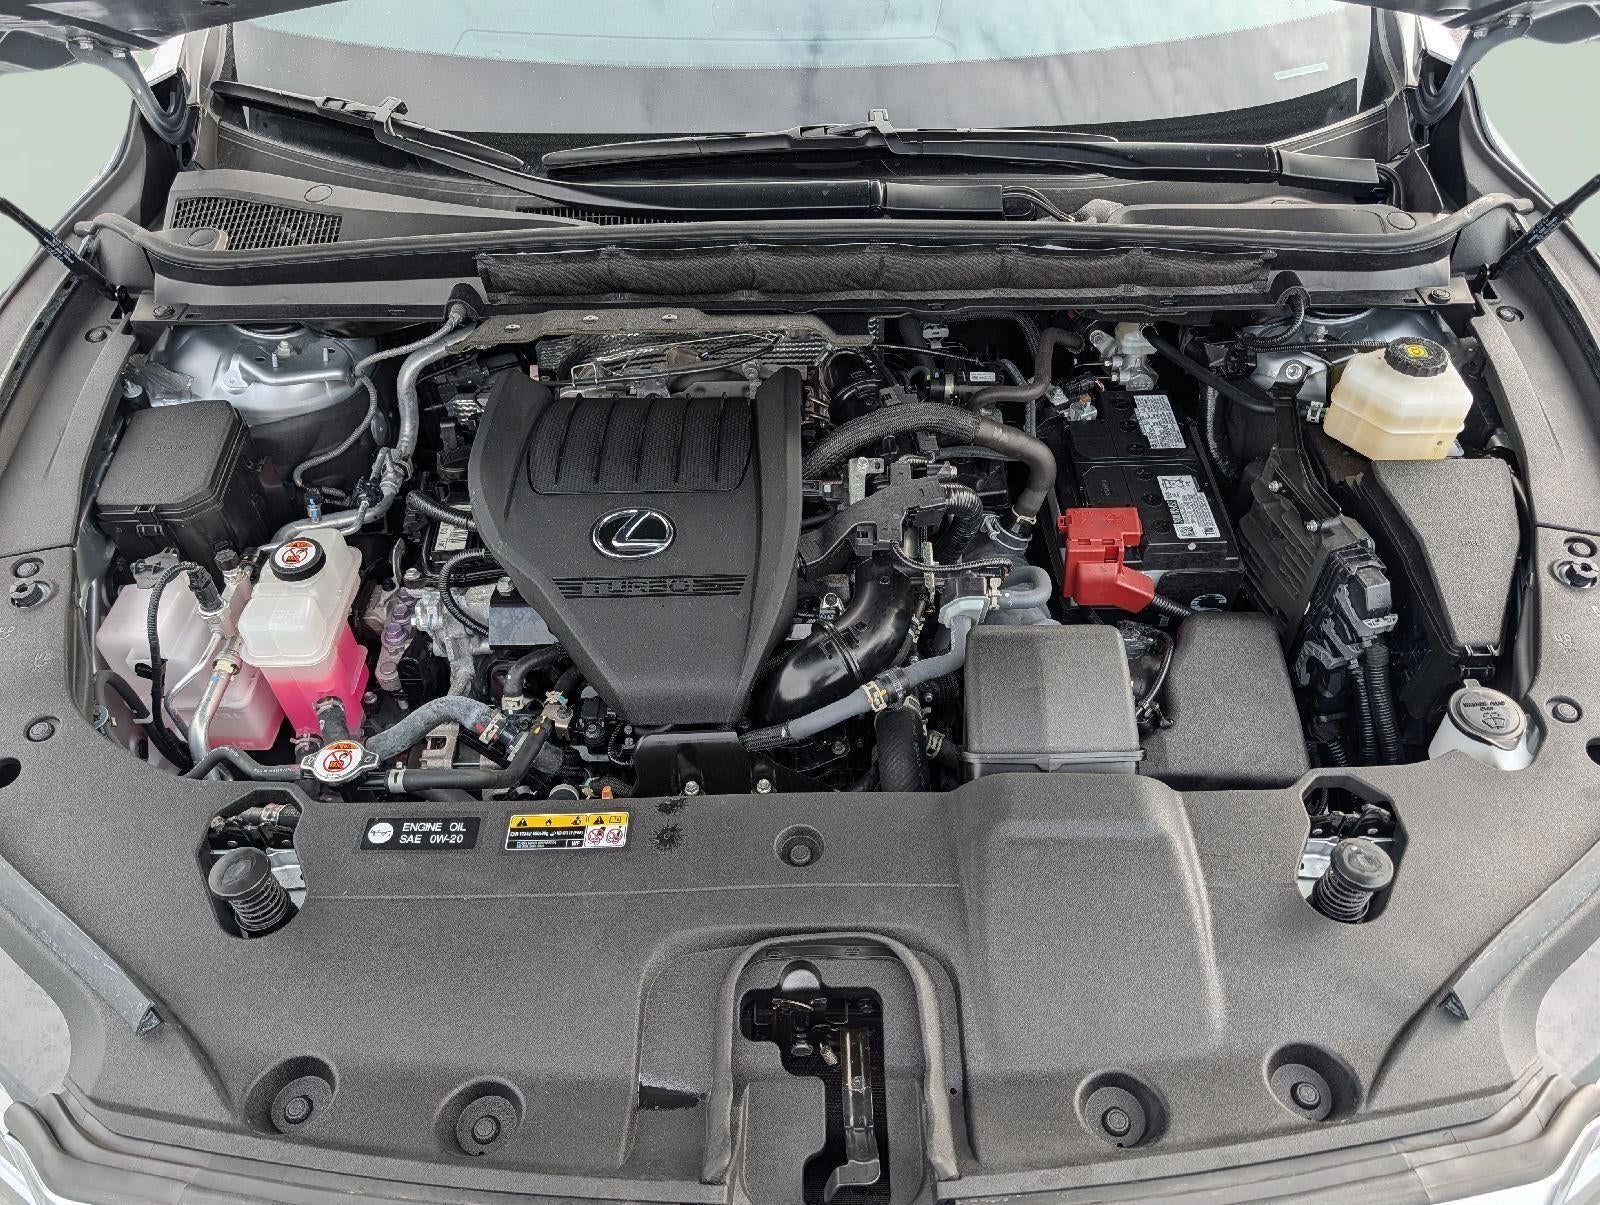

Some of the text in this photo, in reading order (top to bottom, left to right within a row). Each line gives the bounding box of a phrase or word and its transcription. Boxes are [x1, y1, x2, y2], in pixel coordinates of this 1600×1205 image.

[583, 578, 691, 595] TURBO
[402, 822, 467, 832] ENGINE OIL
[399, 834, 464, 844] SAE 0W-20
